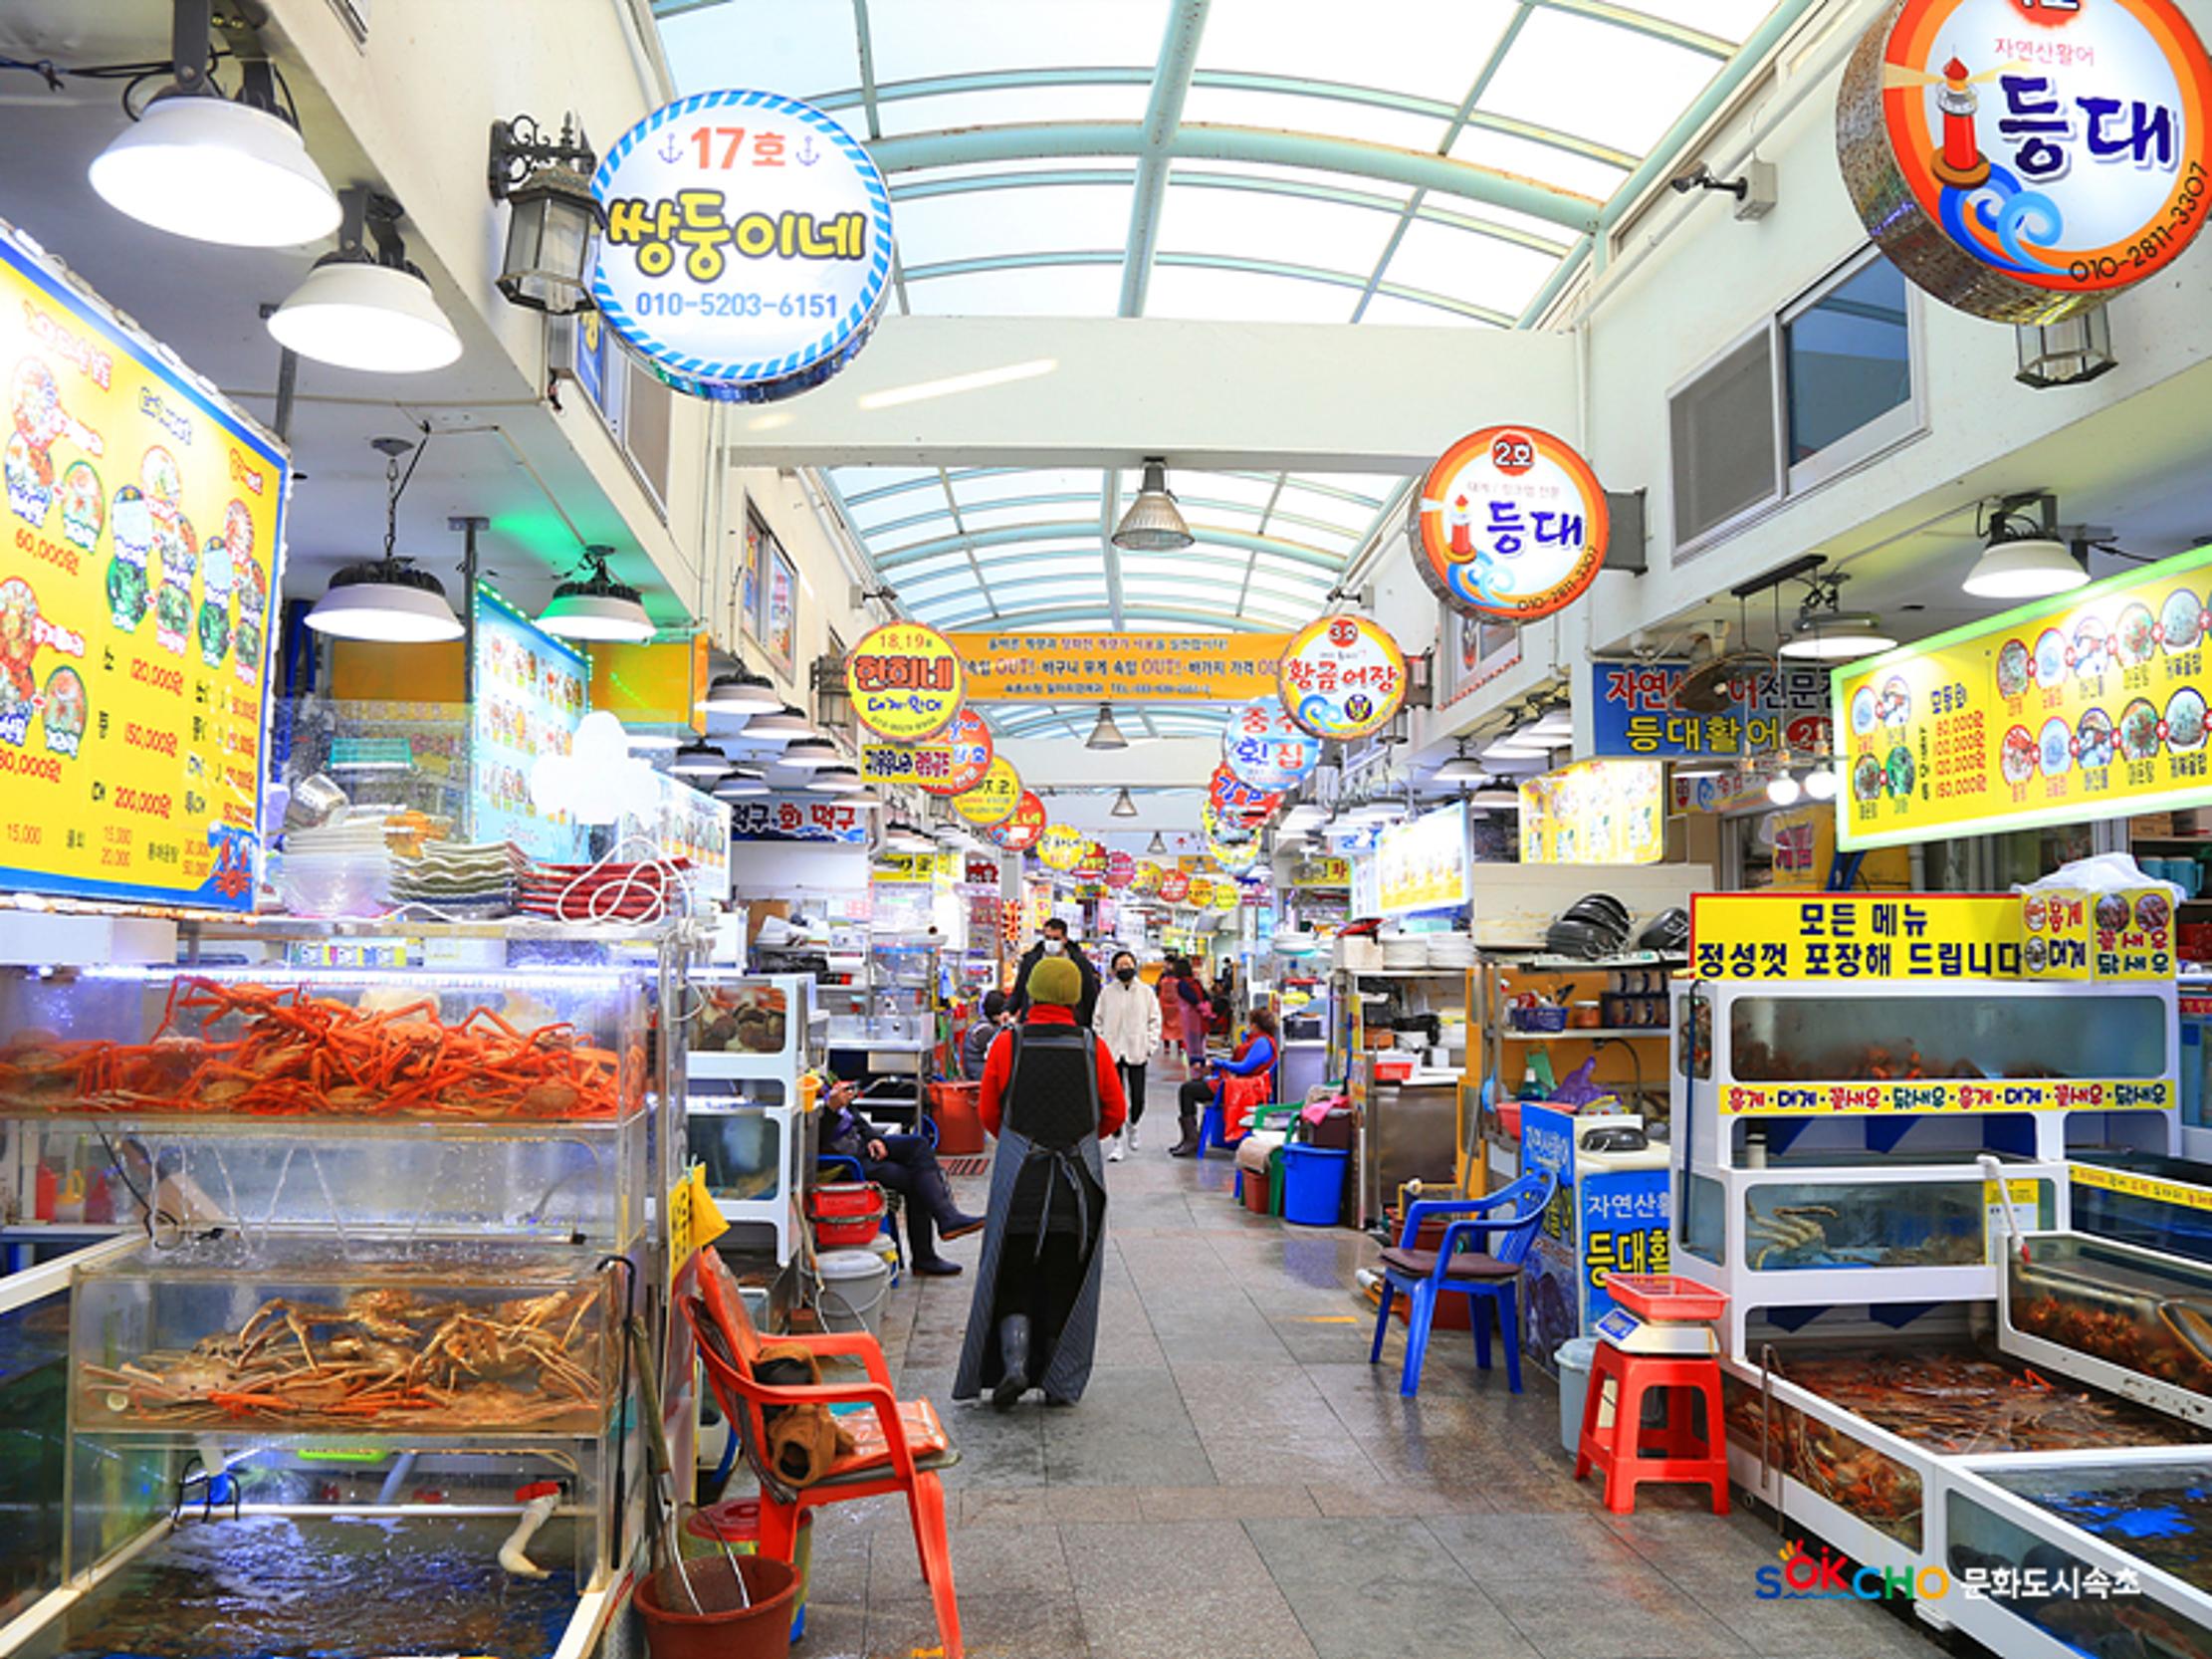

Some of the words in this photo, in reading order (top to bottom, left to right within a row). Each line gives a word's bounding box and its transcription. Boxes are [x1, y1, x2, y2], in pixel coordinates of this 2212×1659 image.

[1994, 38, 2095, 66] 자연산활어
[1999, 75, 2174, 177] 등대
[691, 126, 785, 170] 17호
[607, 188, 867, 284] 쌍둥이네
[2070, 162, 2210, 283] 010-2811-3307
[636, 292, 836, 318] 010-5203-6151
[1494, 441, 1534, 467] 2호
[1487, 501, 1583, 555] 등대
[15, 527, 80, 577] 60,000원
[1257, 658, 1279, 676] OU
[1288, 658, 1399, 693] 황금어장
[124, 722, 177, 759] 150,000원
[1624, 714, 1780, 753] 등대활어
[114, 785, 171, 820] 200,000원
[7, 823, 42, 844] 15,000
[1800, 902, 1858, 938] 모든
[1872, 902, 1928, 938] 메뉴
[1696, 942, 1788, 978] 정성껏
[1805, 942, 1892, 978] 포장해
[1908, 942, 2022, 977] 드립니다
[2049, 939, 2087, 969] 대게
[1777, 1088, 1818, 1107] 대게
[2004, 1086, 2043, 1105] 대게
